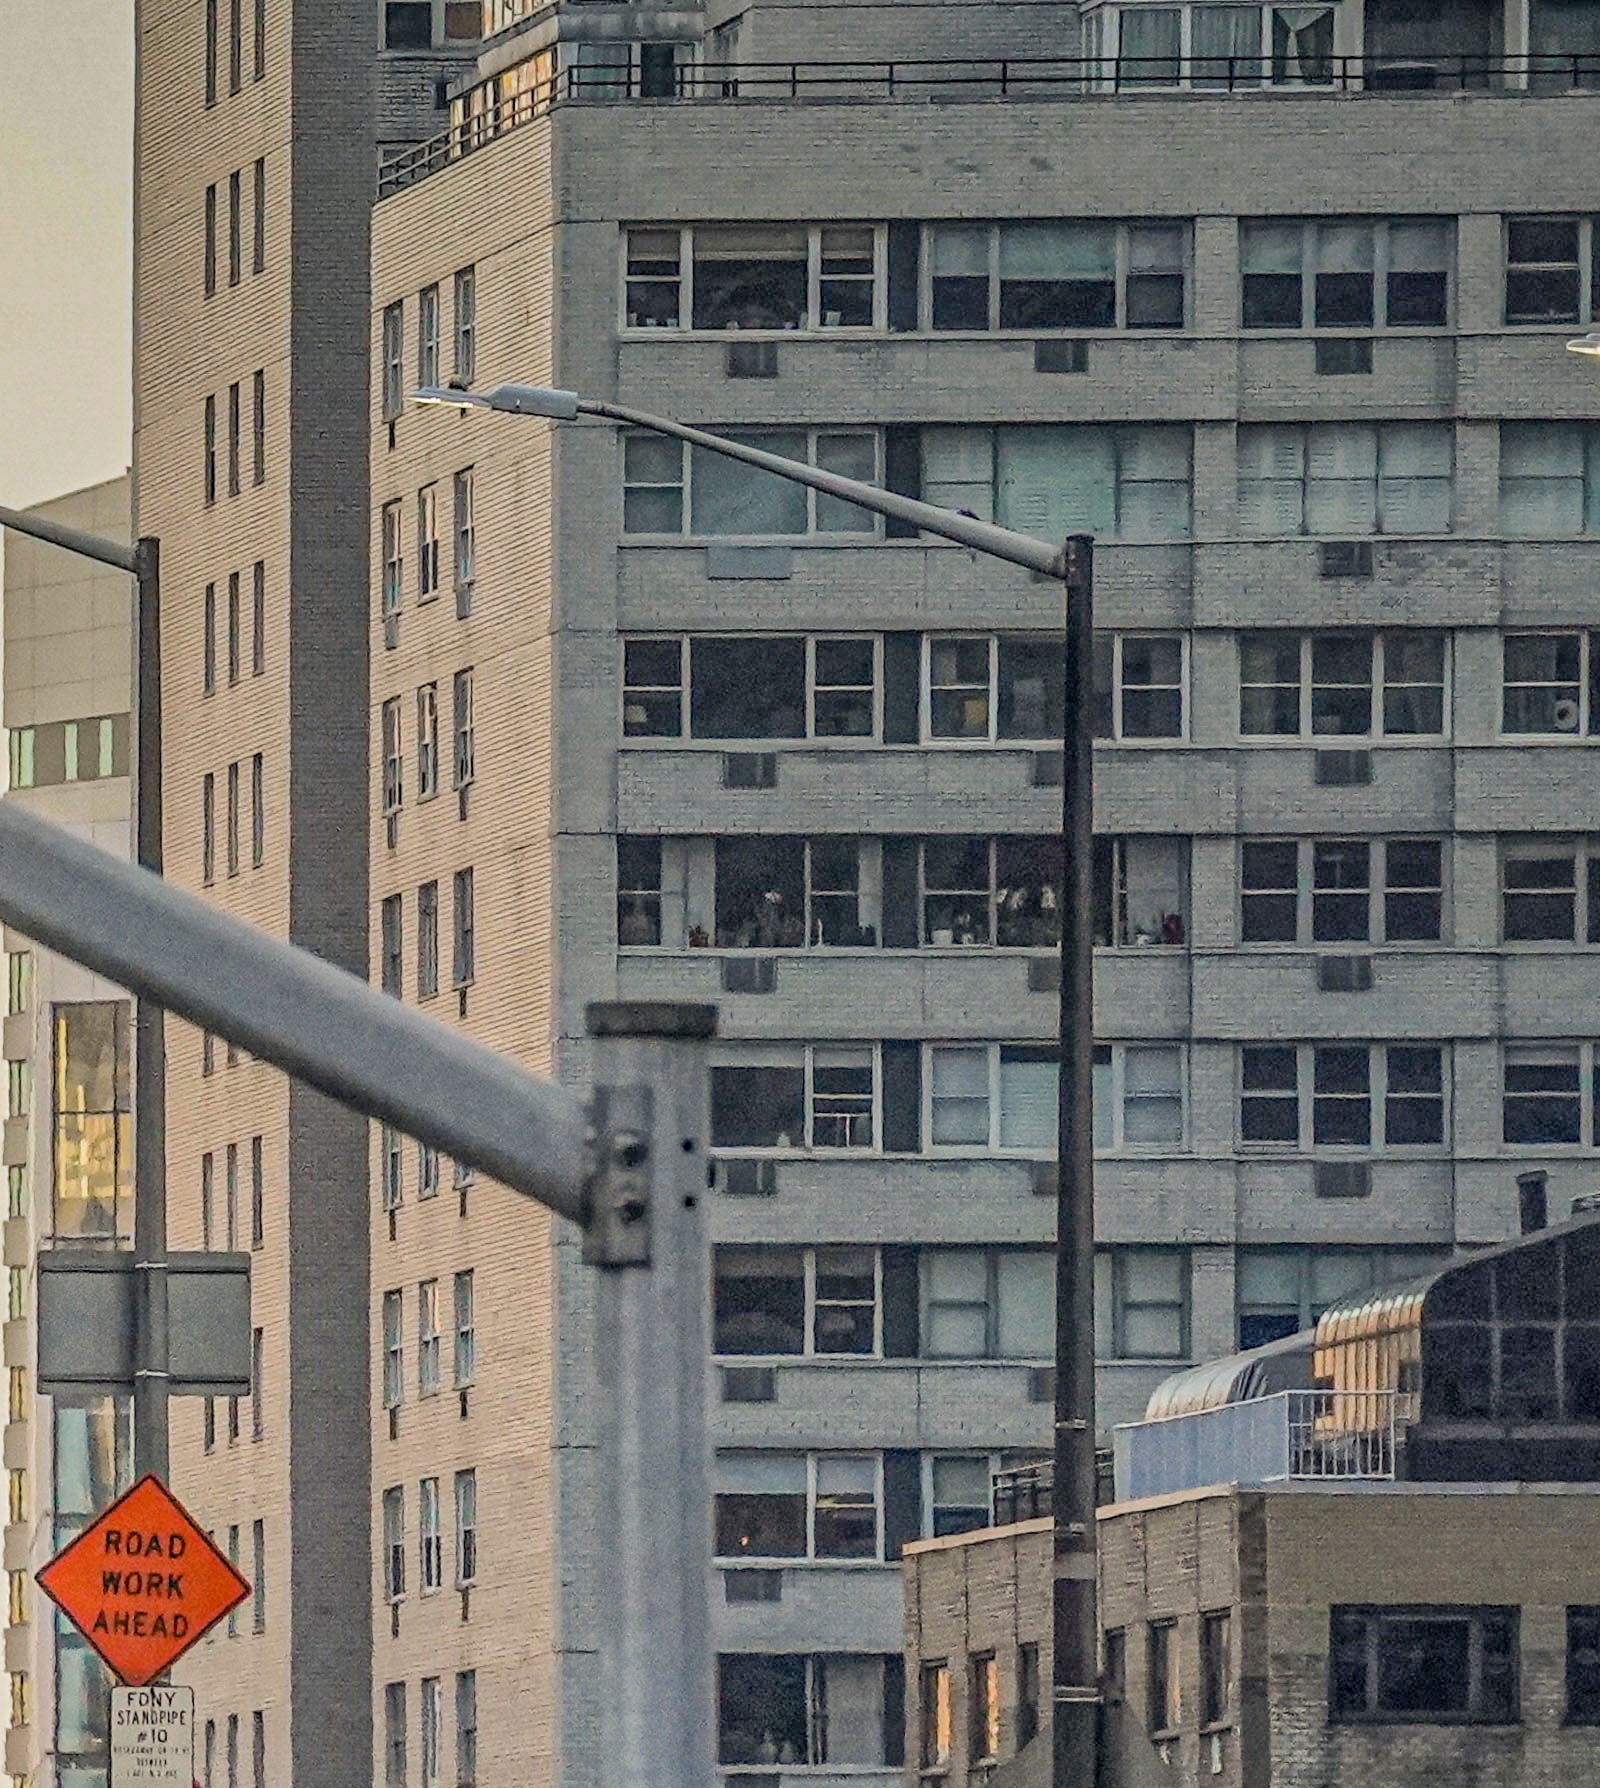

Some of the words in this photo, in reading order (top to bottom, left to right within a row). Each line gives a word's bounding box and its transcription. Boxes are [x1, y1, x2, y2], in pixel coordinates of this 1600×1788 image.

[104, 1529, 187, 1559] ROAD
[101, 1570, 184, 1599] WORK
[91, 1609, 189, 1639] AHEAD
[127, 1692, 177, 1708] FDNY
[116, 1710, 187, 1726] STANDPIPE
